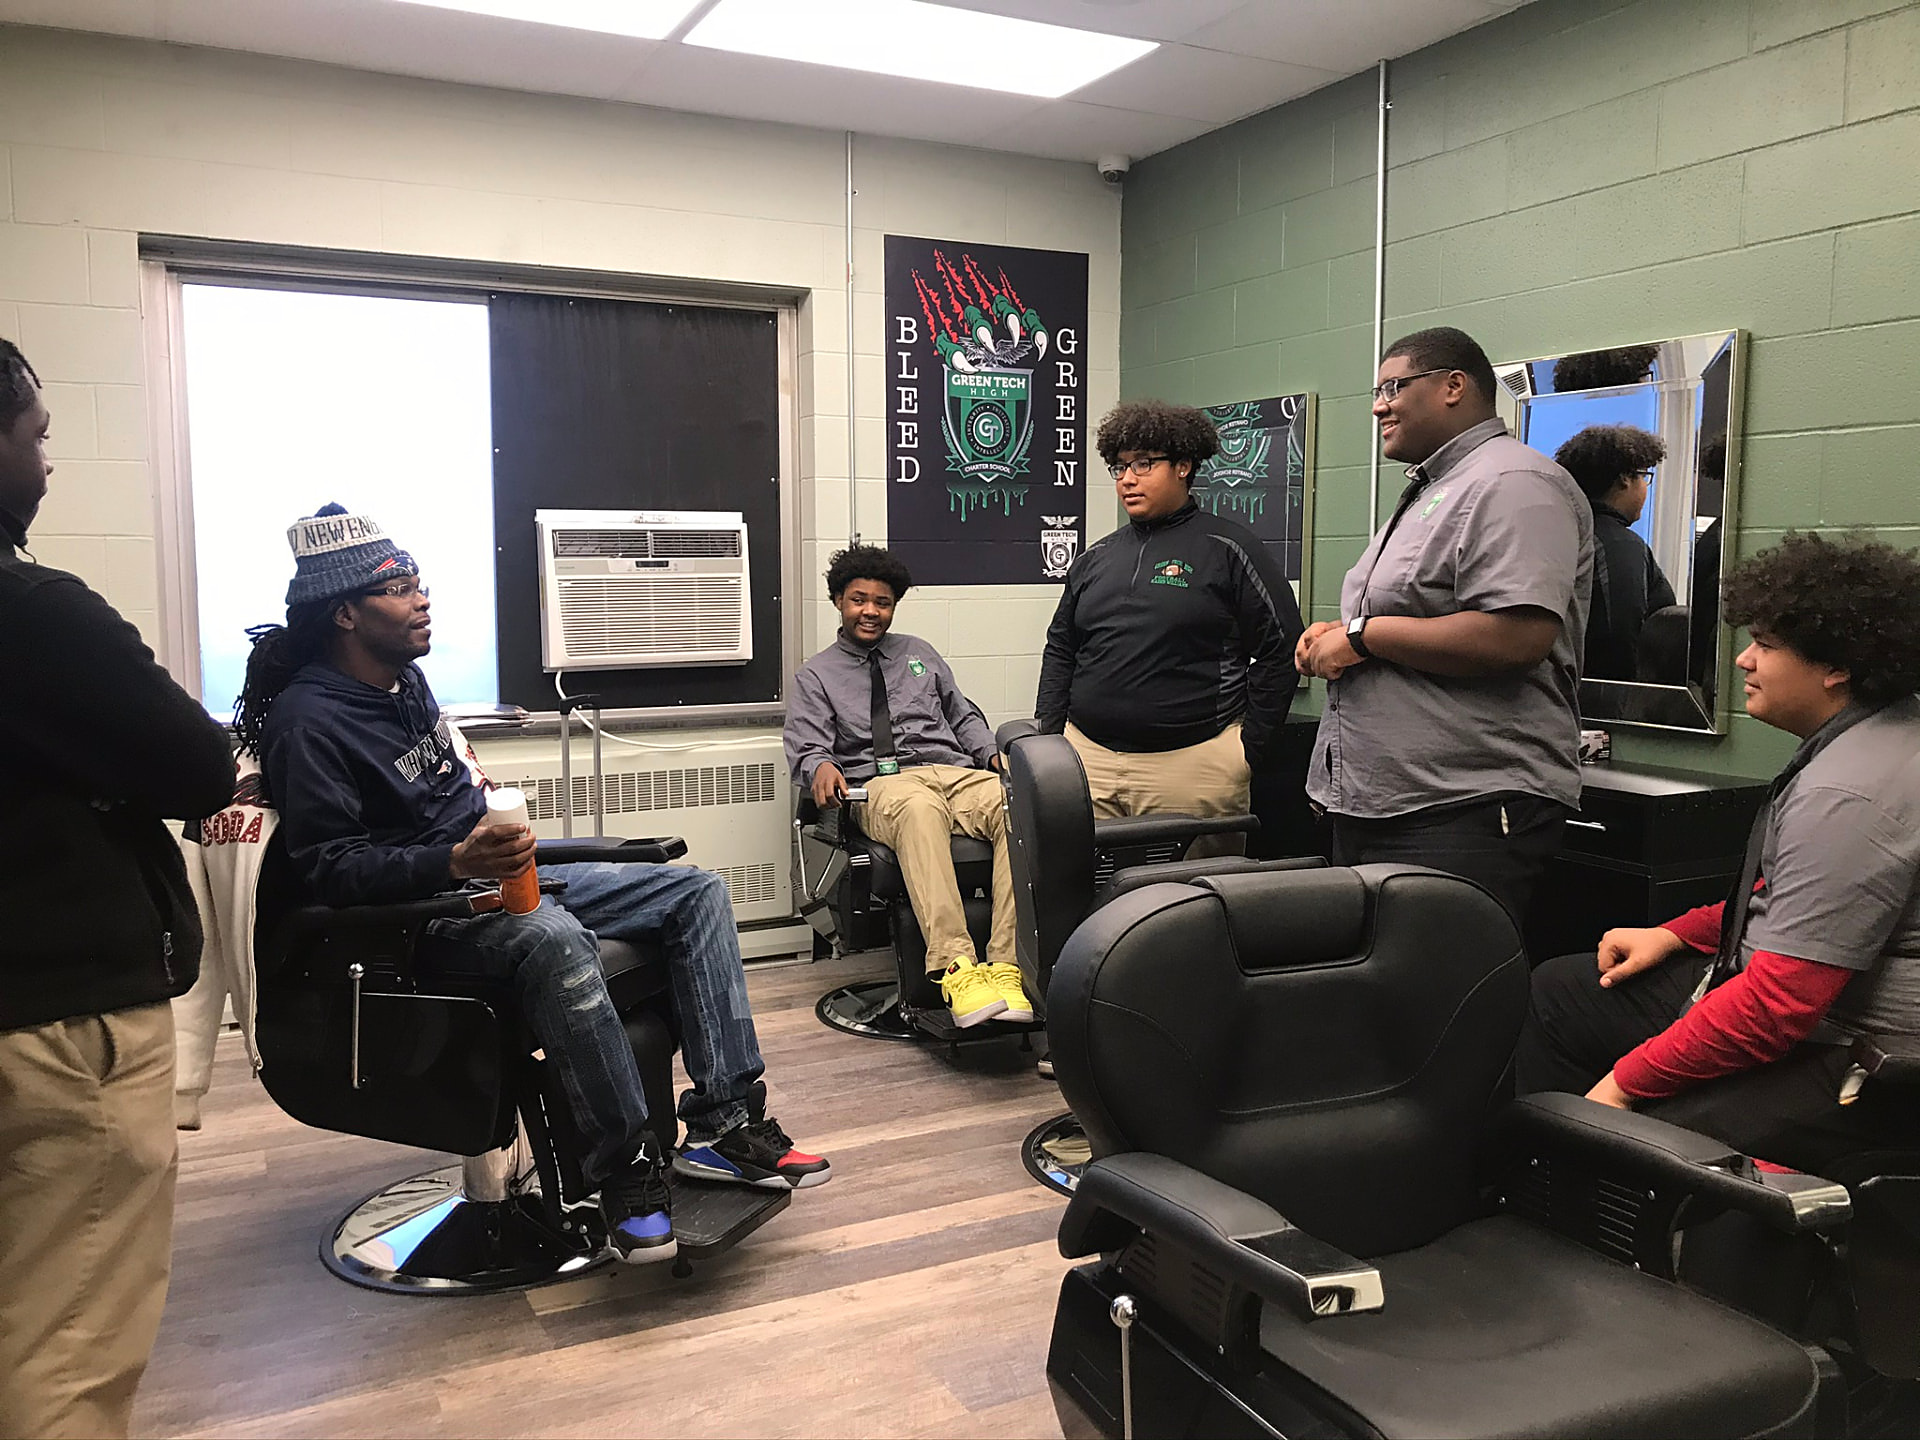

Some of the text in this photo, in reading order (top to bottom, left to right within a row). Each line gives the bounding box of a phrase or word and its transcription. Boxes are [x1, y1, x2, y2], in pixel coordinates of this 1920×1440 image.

[951, 374, 1026, 389] GREEN TECH
[970, 388, 1008, 397] HIGH
[895, 316, 919, 483] BLEED
[1053, 328, 1078, 486] GREEN
[964, 463, 1011, 474] CHARTER SCHOOL
[304, 520, 345, 549] NEW
[201, 810, 264, 848] SODA
